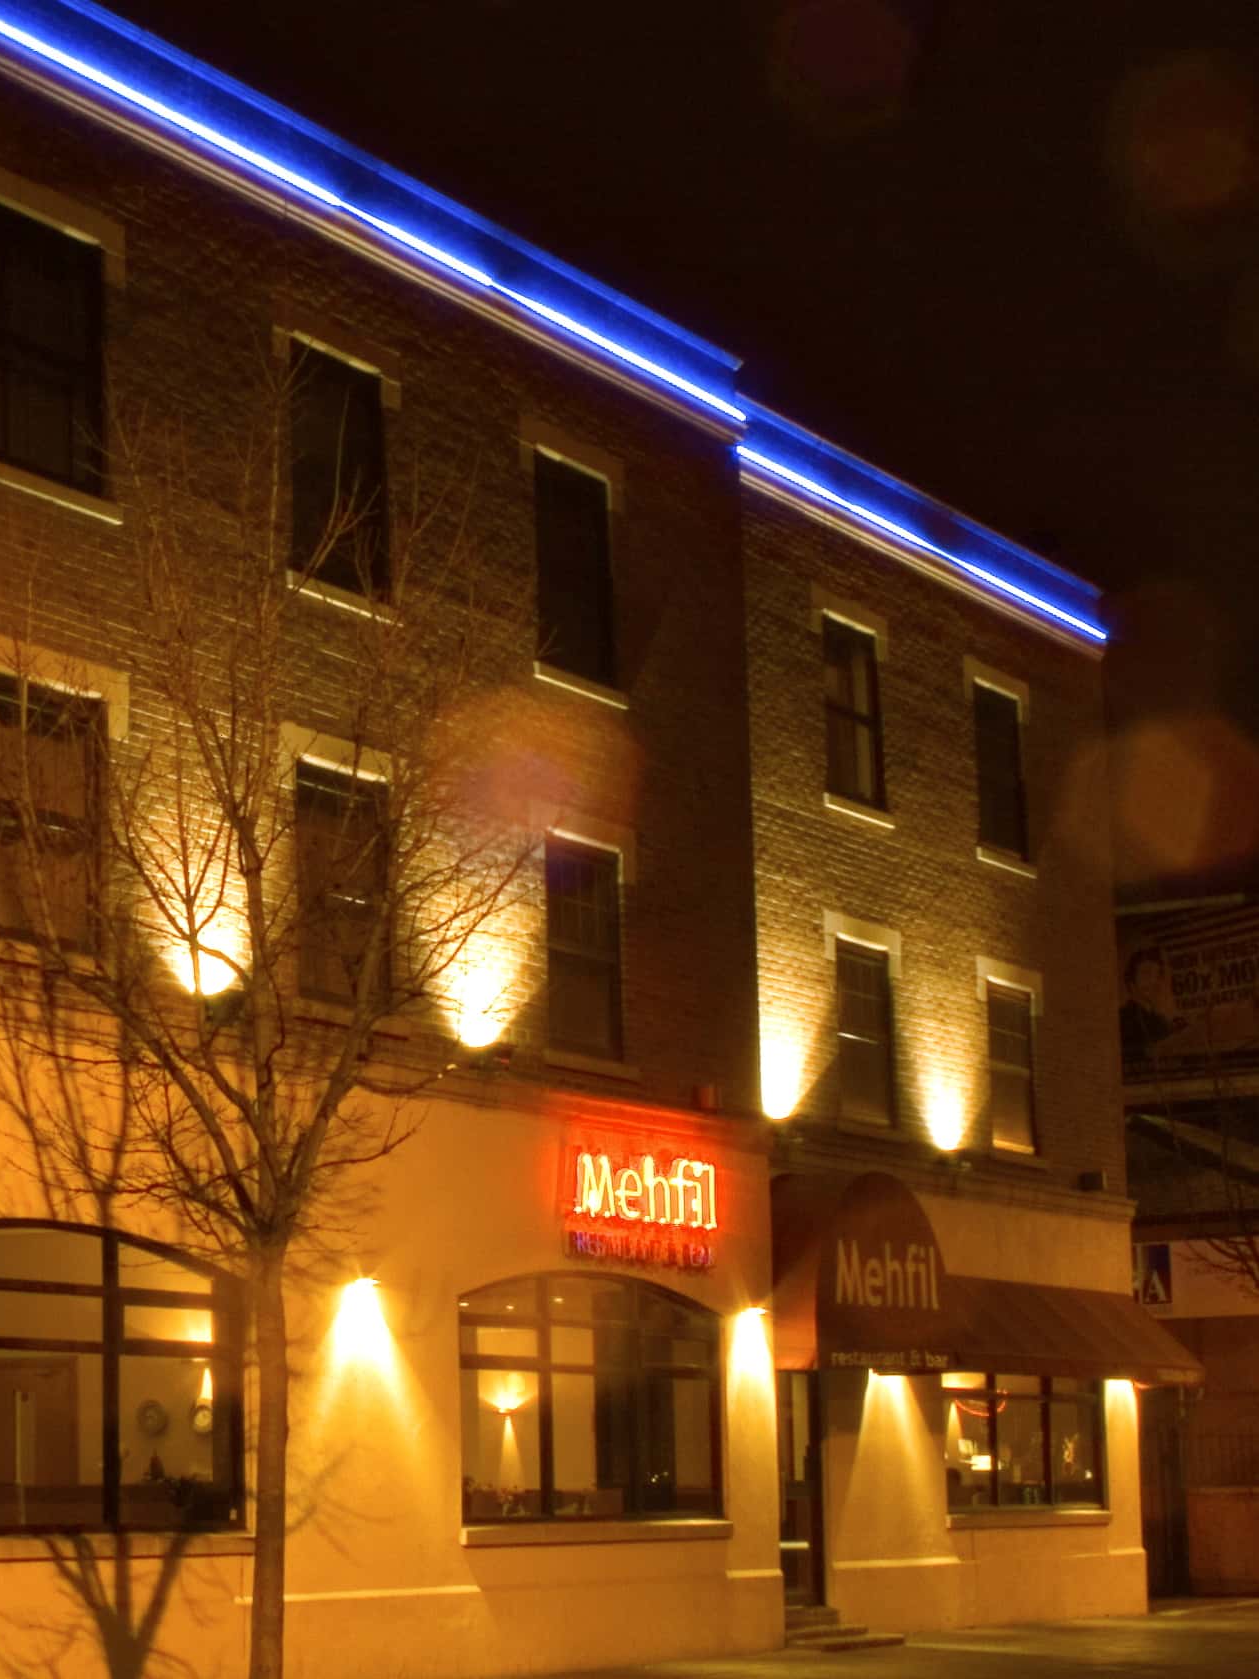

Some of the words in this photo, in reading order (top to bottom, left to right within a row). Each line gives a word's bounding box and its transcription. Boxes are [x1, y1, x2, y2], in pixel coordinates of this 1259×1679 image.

[573, 1152, 717, 1230] Mehfil
[835, 1239, 940, 1311] Mehfil
[831, 1351, 905, 1368] restaurant
[925, 1351, 949, 1368] bar
